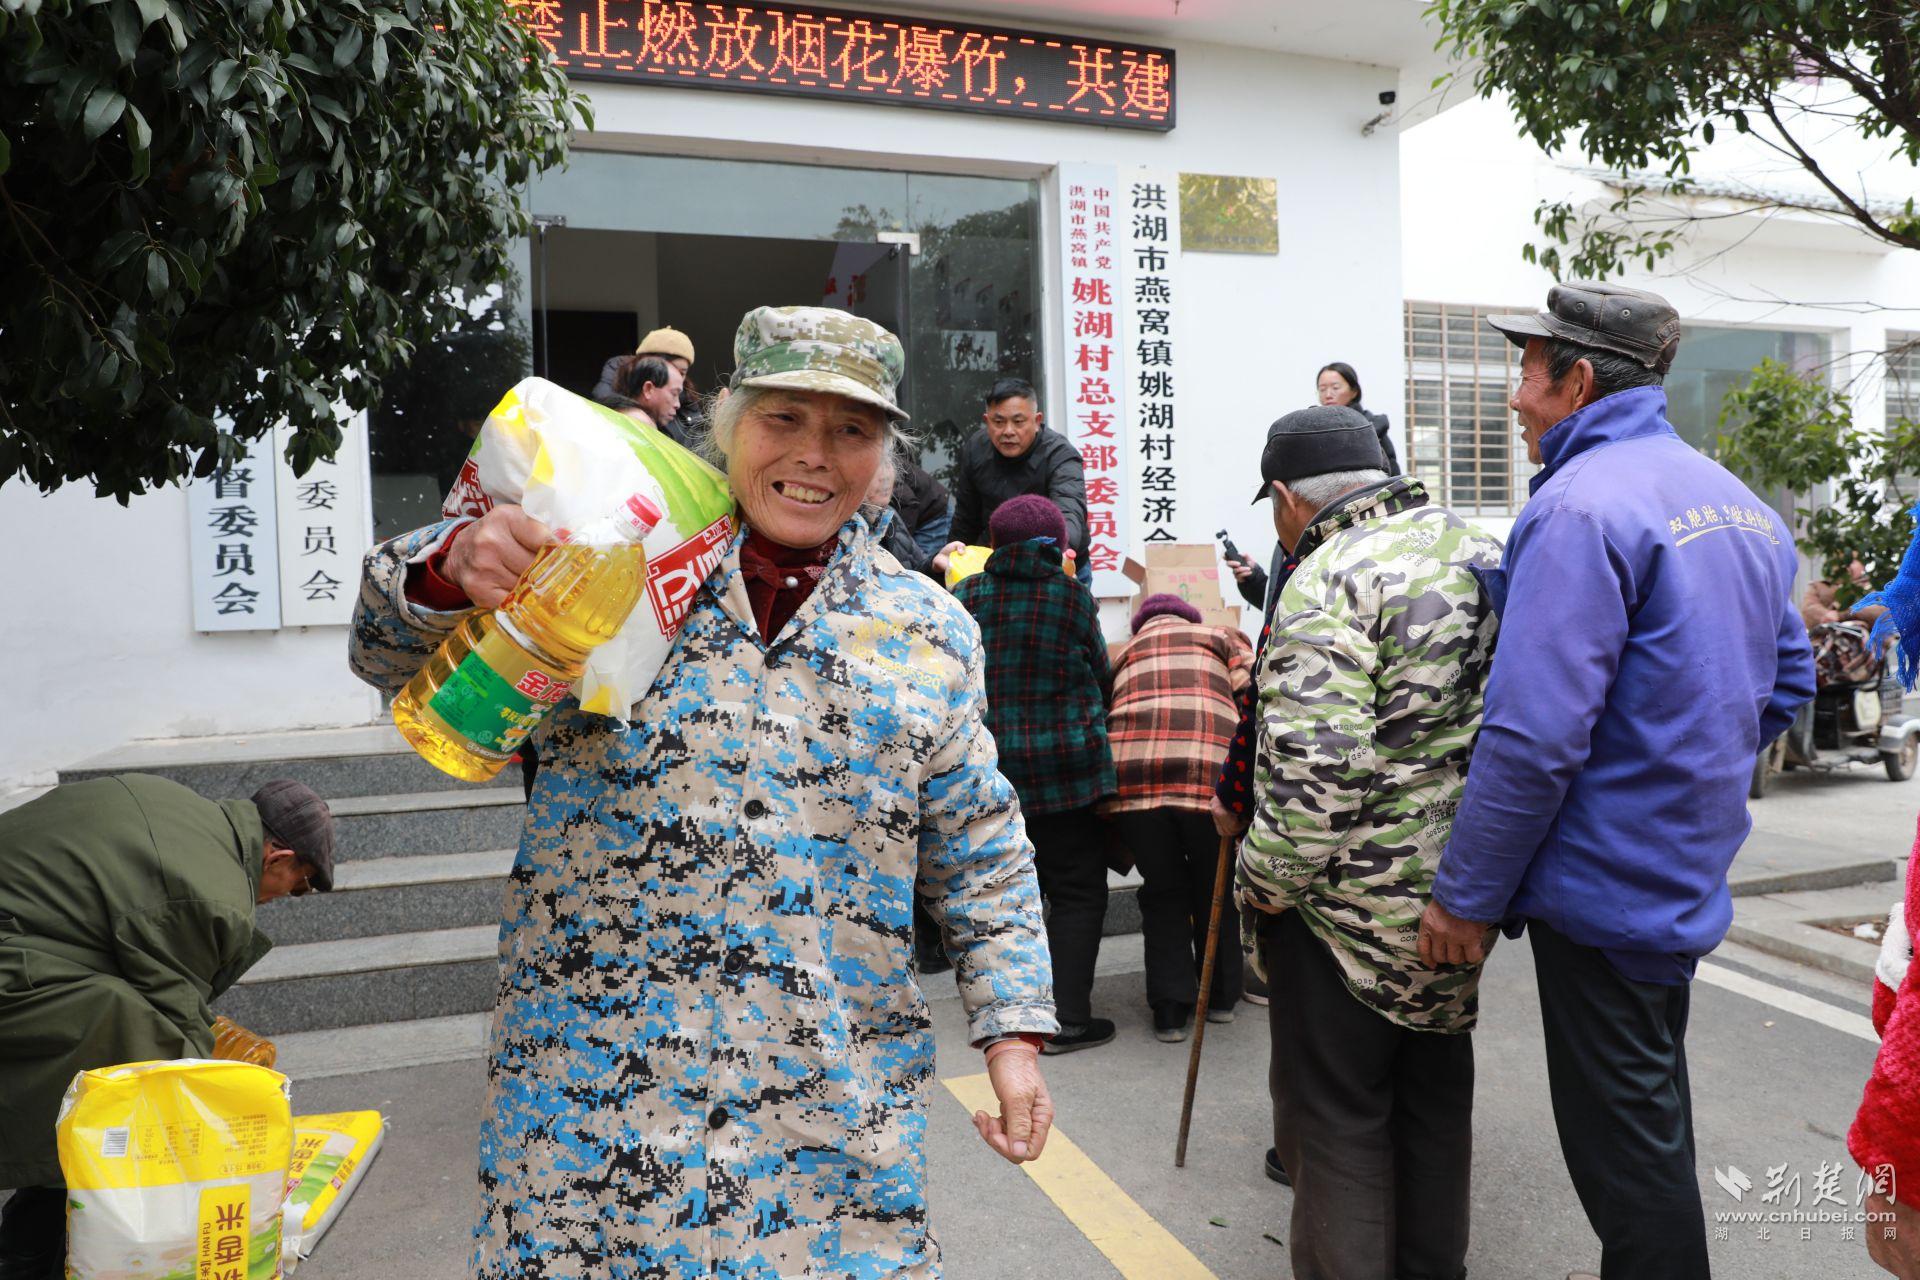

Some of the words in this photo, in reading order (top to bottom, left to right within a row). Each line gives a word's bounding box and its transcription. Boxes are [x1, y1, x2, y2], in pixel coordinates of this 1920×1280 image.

[1068, 185, 1088, 269] 洪湖市燕窝镇
[1093, 187, 1112, 270] 中国共产党
[1072, 277, 1121, 572] 姚湖村总支部委员会
[207, 450, 260, 615] 督委员会
[296, 457, 343, 601] 委员会
[203, 1222, 211, 1235] FU
[203, 1237, 211, 1257] HAN
